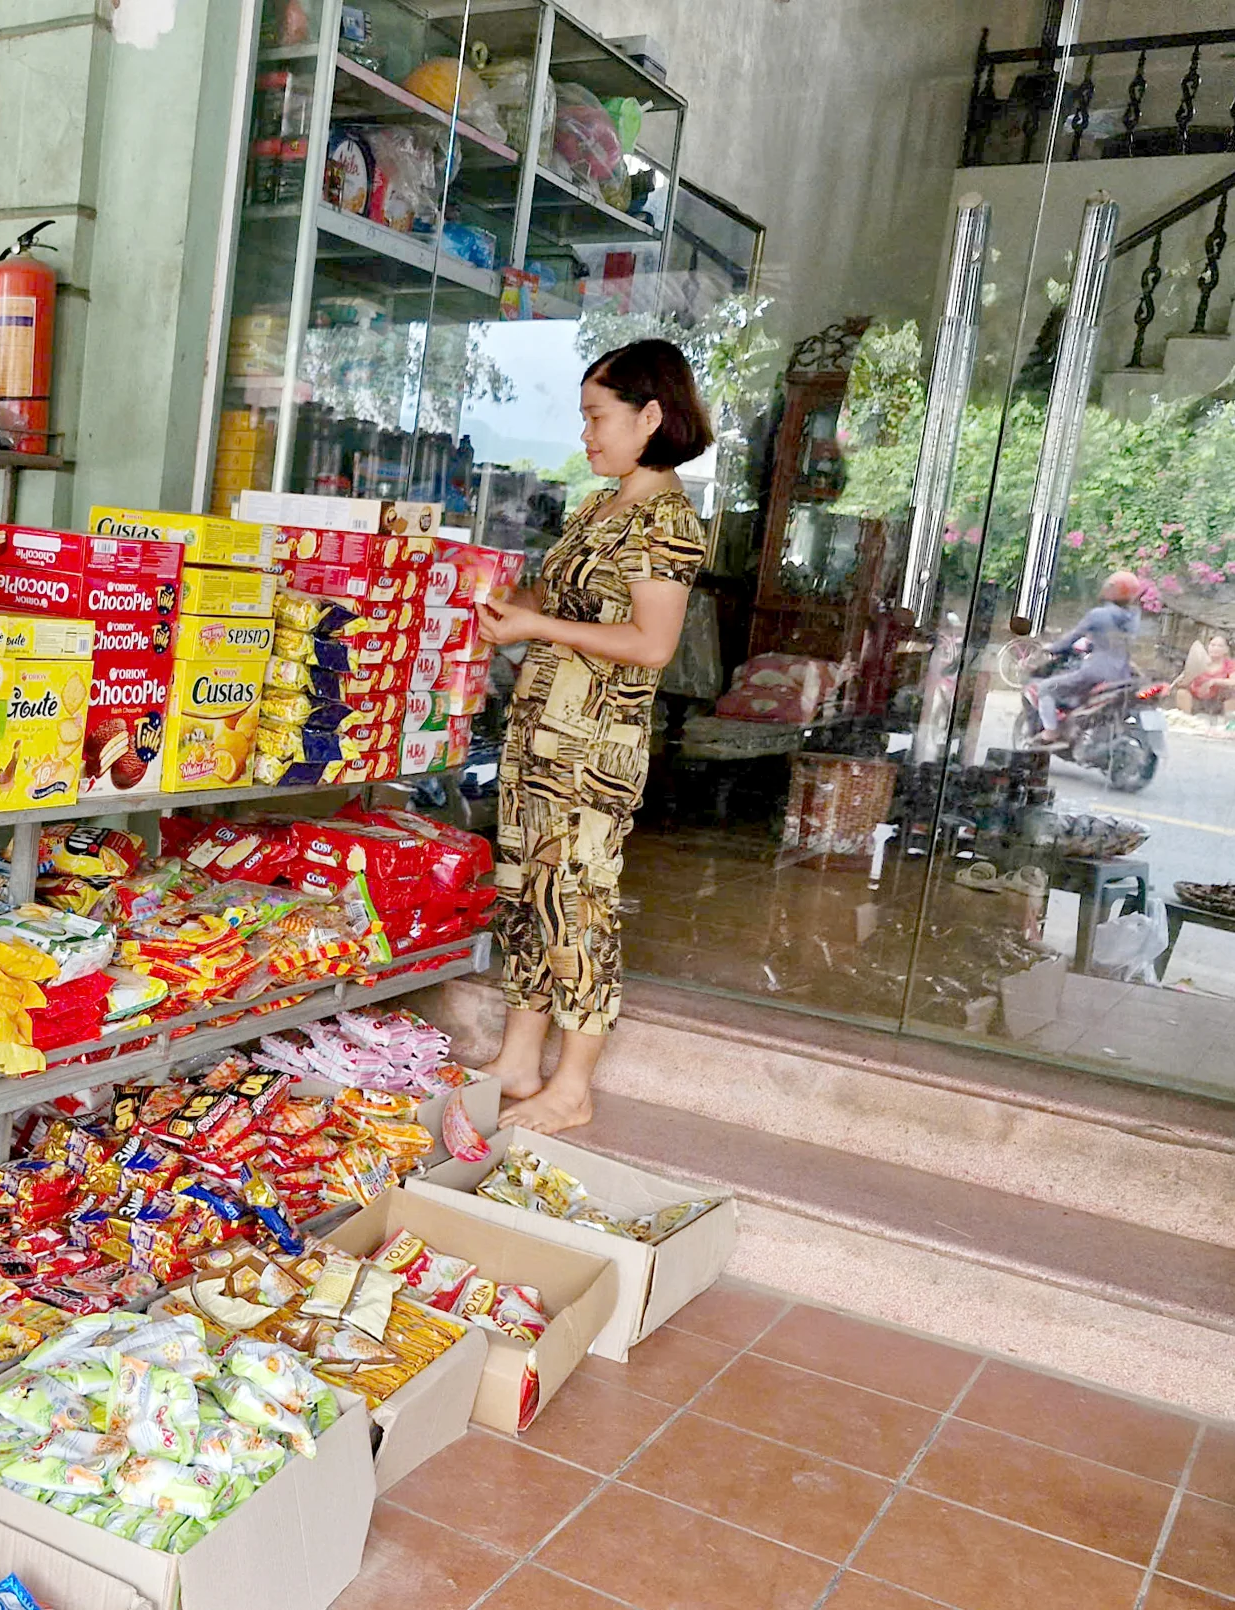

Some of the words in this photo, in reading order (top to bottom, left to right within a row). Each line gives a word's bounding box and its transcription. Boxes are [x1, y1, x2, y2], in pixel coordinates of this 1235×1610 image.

[97, 518, 161, 540] Custas
[16, 551, 56, 563] ChocoPie
[116, 582, 138, 592] ORION
[88, 589, 153, 612] ChocoPie
[115, 622, 135, 631] ORION
[93, 629, 149, 651] ChocoPie
[227, 628, 270, 649] Custas
[118, 668, 148, 680] ORION
[89, 678, 165, 706] ChocoPie
[192, 677, 254, 704] Custas
[311, 840, 332, 853] COSY
[306, 871, 327, 884] COSY
[240, 1074, 269, 1096] 90
[184, 1095, 213, 1117] 90
